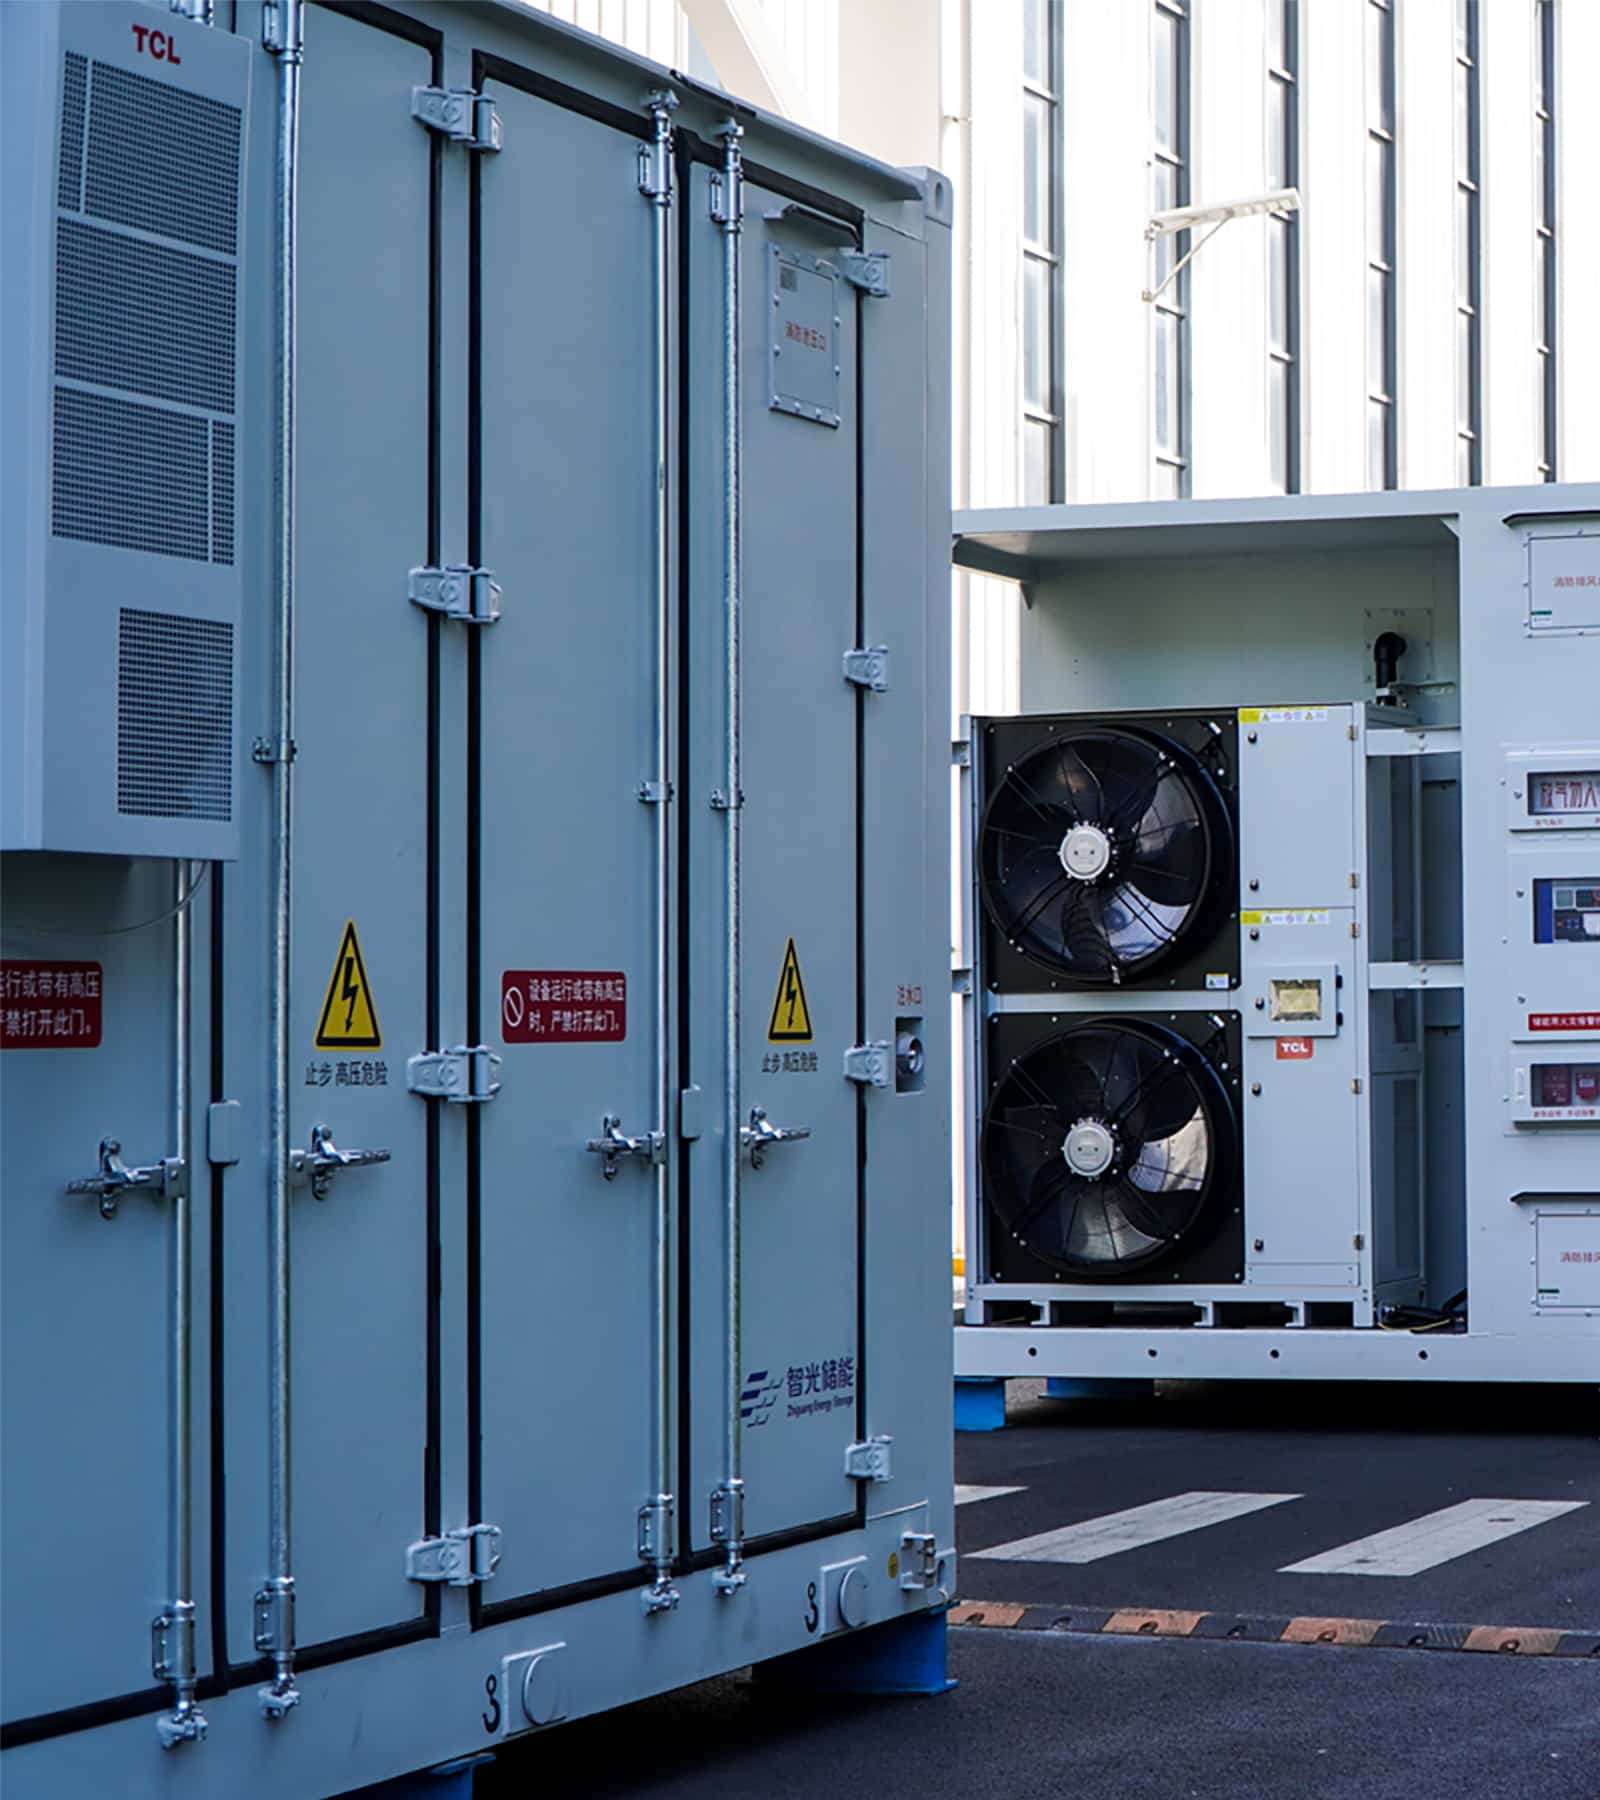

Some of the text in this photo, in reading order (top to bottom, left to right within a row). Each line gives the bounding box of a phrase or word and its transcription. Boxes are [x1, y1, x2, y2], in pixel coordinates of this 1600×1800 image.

[132, 24, 181, 65] TCL
[0, 970, 100, 998] 行或带有高压
[1281, 1042, 1308, 1053] TCL
[787, 1357, 854, 1398] 智光储能
